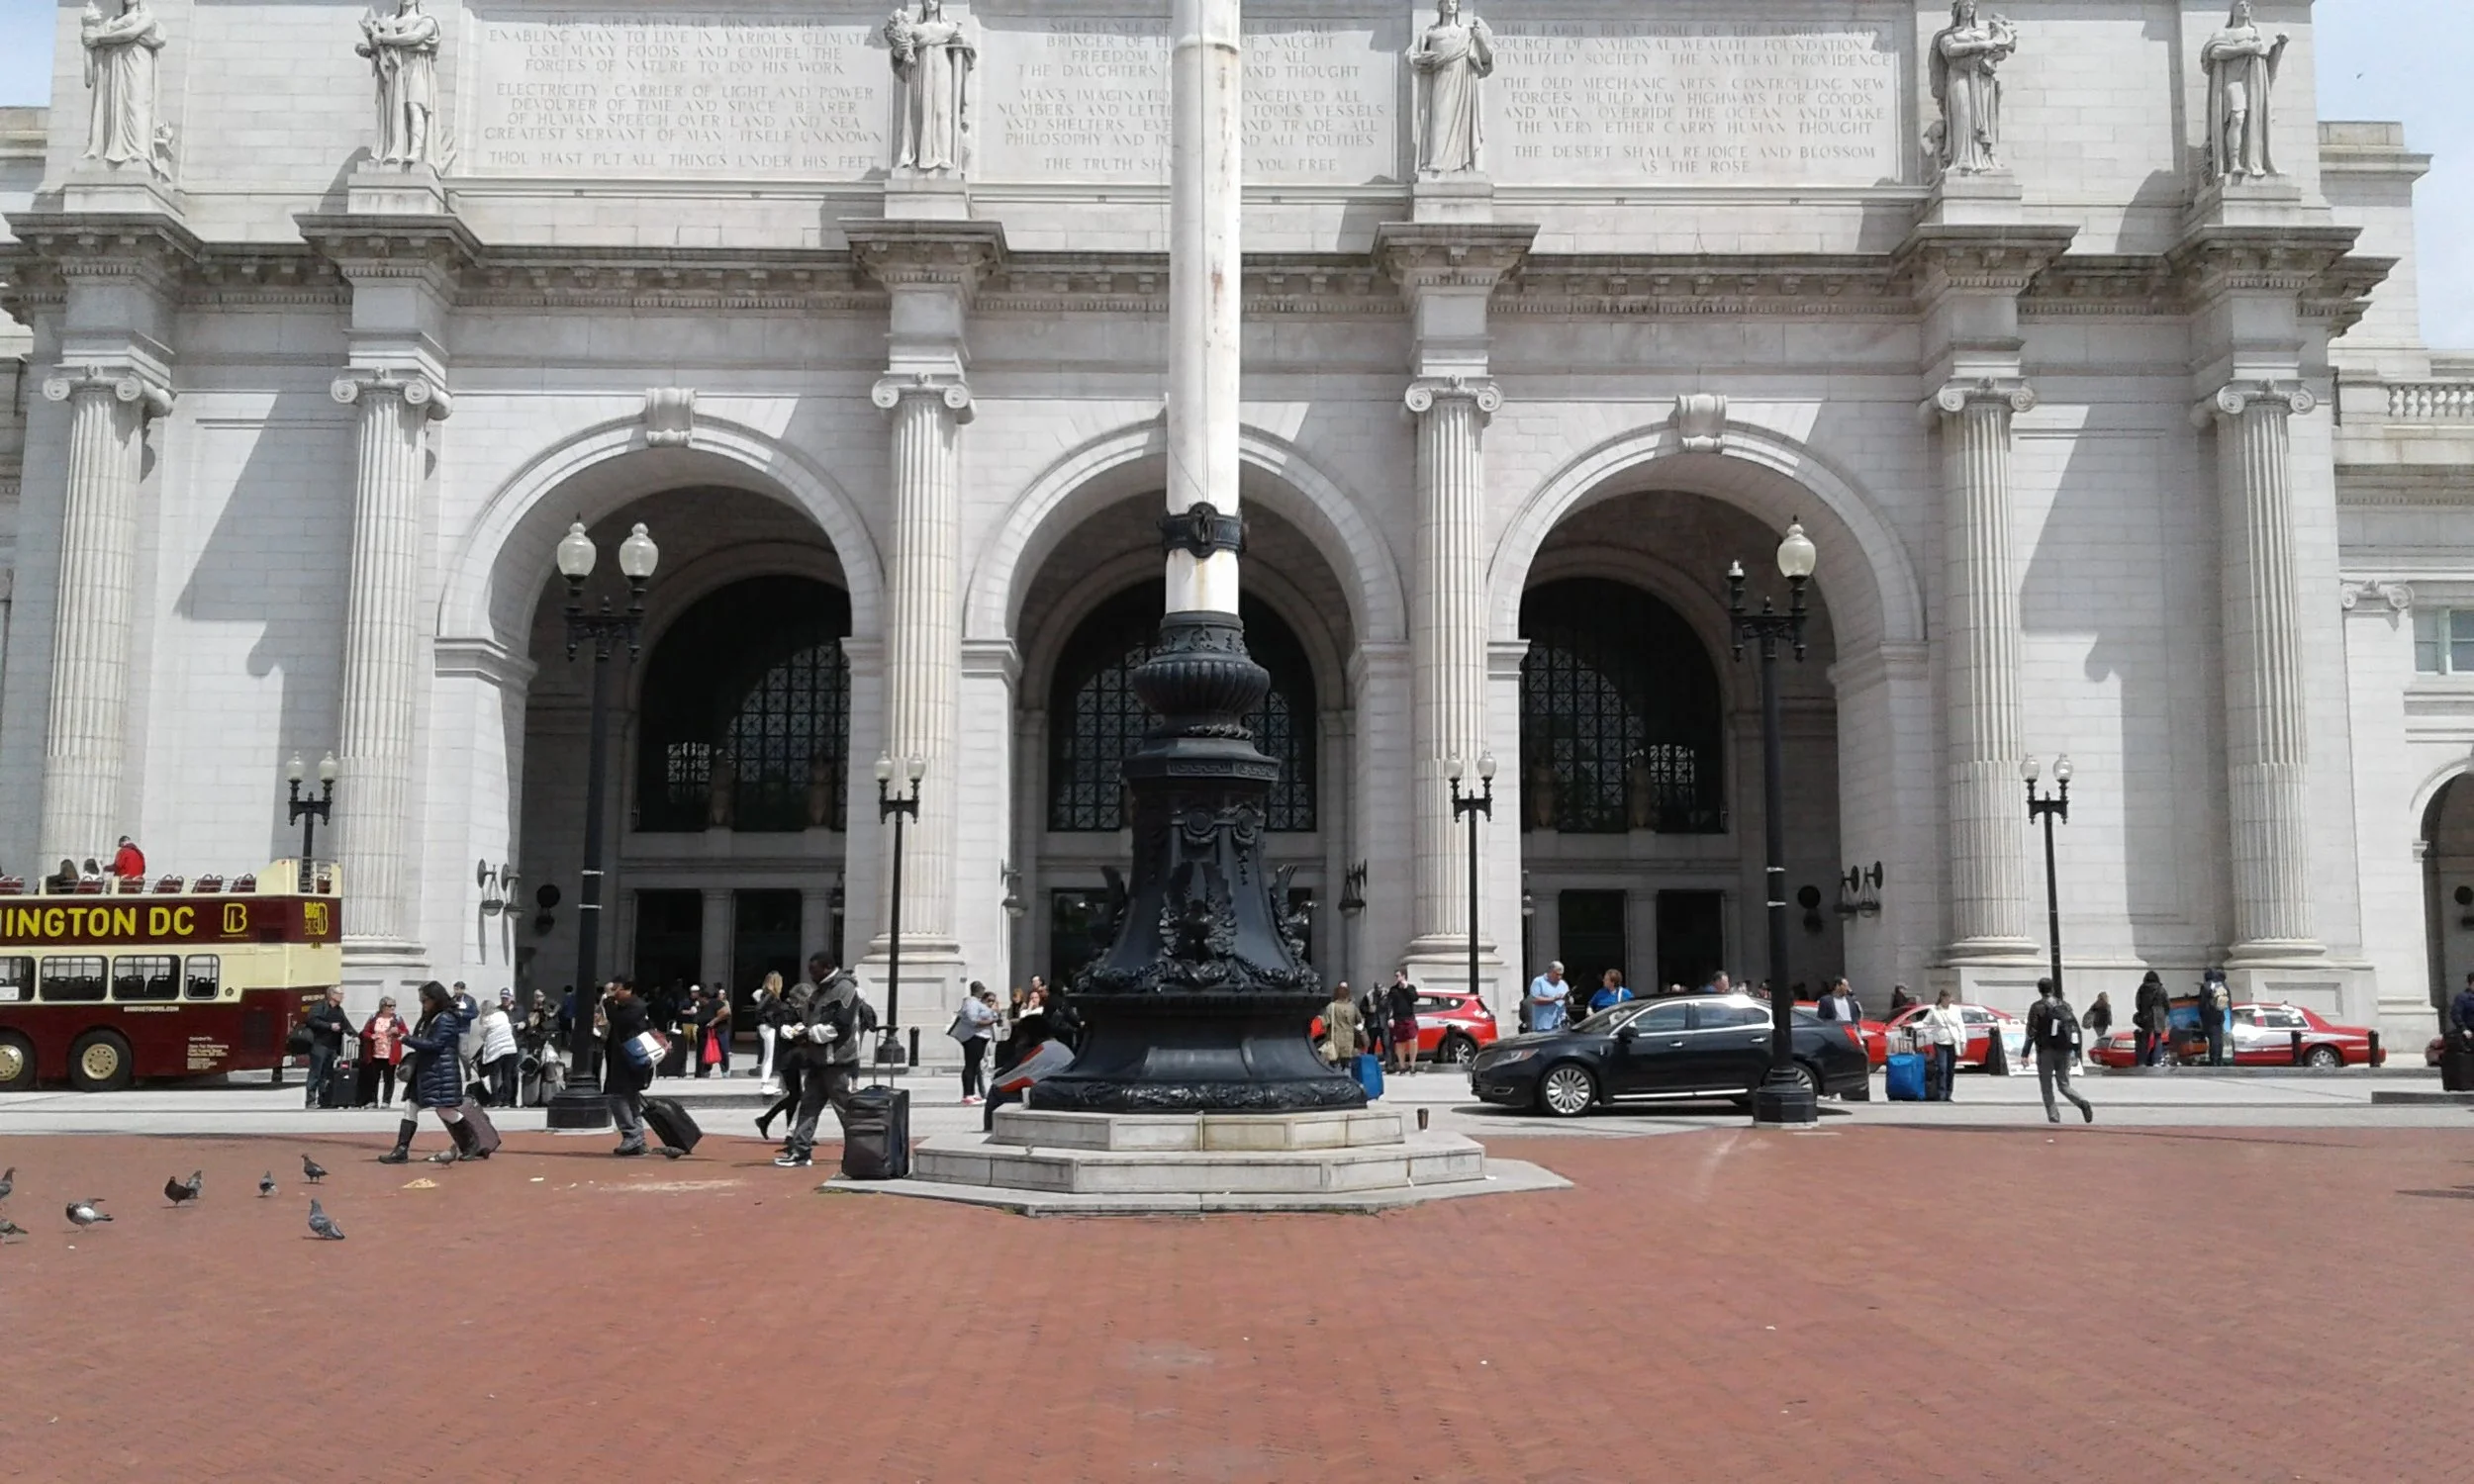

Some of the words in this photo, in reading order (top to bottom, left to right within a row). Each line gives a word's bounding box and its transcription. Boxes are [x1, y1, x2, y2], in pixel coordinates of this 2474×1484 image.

[489, 30, 570, 43] ENABLING
[581, 31, 615, 43] MAN
[625, 31, 645, 44] TO
[655, 31, 689, 44] LIVE
[699, 31, 712, 44] IN
[725, 31, 793, 44] VARIOUS
[1046, 37, 1114, 47] BRINGER
[1125, 38, 1146, 48] OF
[1240, 37, 1259, 48] OF
[1270, 37, 1334, 49] NAUGHT
[1493, 39, 1558, 49] SOURCE
[1566, 39, 1584, 49] OF
[1596, 40, 1673, 50] NATIONAL
[1680, 40, 1747, 51] WEALTH
[1764, 41, 1862, 51] FOUNDATION
[1872, 41, 1891, 51] OF
[529, 45, 560, 56] USE
[571, 45, 618, 57] MANY
[627, 46, 680, 57] FOODS
[696, 46, 728, 57] AND
[738, 46, 801, 59] COMPEL
[814, 47, 842, 60] THE
[1072, 50, 1148, 62] FREEDOM
[1254, 51, 1271, 62] OF
[1284, 51, 1308, 63] ALL
[1495, 53, 1574, 65] CIVILIZED
[1584, 53, 1649, 65] SOCIETY
[1670, 54, 1699, 65] THE
[1710, 54, 1778, 66] NATURAL
[1792, 55, 1891, 66] PROVIDENCE
[525, 59, 587, 71] FORCES
[597, 59, 616, 72] OF
[626, 60, 688, 72] NATURE
[699, 61, 719, 73] TO
[729, 61, 752, 73] DO
[763, 61, 788, 74] HIS
[799, 61, 844, 75] WORK
[1017, 64, 1051, 77] THE
[1063, 65, 1158, 77] DAUGHTERS
[1244, 66, 1277, 78] AND
[1285, 66, 1361, 78] THOUGHT
[1501, 77, 1530, 89] THE
[1542, 78, 1572, 89] OLD
[1582, 78, 1668, 90] MECHANIC
[1679, 78, 1716, 90] ARTS
[1852, 79, 1885, 90] NEW
[497, 83, 598, 96] ELECTRICITY
[616, 84, 683, 97] CARRIER
[692, 85, 710, 97] OF
[722, 86, 767, 98] LIGHT
[778, 86, 810, 98] AND
[820, 87, 874, 100] POWER
[1078, 89, 1170, 102] IMAGINATIO
[1242, 90, 1324, 102] ONCEIVED
[1335, 91, 1362, 102] ALL
[1512, 92, 1572, 104] FORCES
[1586, 92, 1634, 104] BUILD
[1643, 92, 1674, 104] NEW
[1687, 92, 1765, 104] HIGHWAYS
[1778, 93, 1806, 104] FOR
[1818, 93, 1873, 104] GOODS
[513, 98, 597, 112] DEVOURER
[607, 99, 626, 112] OF
[638, 99, 672, 112] TIME
[686, 100, 716, 113] AND
[728, 101, 776, 114] SPACE
[796, 101, 857, 114] BEARER
[998, 104, 1074, 116] NUMBERS
[1087, 104, 1118, 116] AND
[1253, 105, 1303, 117] TOOLS
[1314, 105, 1385, 118] VESSELS
[1503, 107, 1536, 119] AND
[1547, 107, 1580, 118] MEN
[1598, 108, 1674, 119] OVERRIDE
[1686, 108, 1715, 119] THE
[1725, 108, 1781, 119] OCEAN
[1798, 108, 1830, 120] AND
[1840, 108, 1886, 120] MAKE
[508, 113, 525, 125] OF
[538, 113, 597, 125] HUMAN
[609, 113, 668, 127] SPEECH
[678, 114, 719, 127] OVER
[730, 116, 775, 128] LAND
[788, 116, 820, 129] AND
[830, 116, 860, 129] SEA
[1005, 119, 1037, 131] AND
[1048, 120, 1124, 132] SHELTERS
[1241, 121, 1272, 132] AND
[1283, 121, 1333, 132] TRADE
[1351, 121, 1378, 133] ALL
[484, 128, 566, 139] GREATEST
[576, 128, 646, 140] SERVANT
[657, 129, 676, 141] OF
[685, 130, 721, 141] MAN
[739, 130, 792, 142] ITSELF
[802, 131, 882, 143] UNKNOWN
[1516, 122, 1544, 134] THE
[1553, 122, 1592, 134] VERY
[1605, 122, 1655, 134] ETHER
[1665, 123, 1716, 134] CARRY
[1727, 123, 1785, 135] HUMAN
[1797, 123, 1872, 135] THOUGHT
[1005, 134, 1101, 145] PHILOSOPHY
[1113, 135, 1145, 146] AND
[1272, 137, 1294, 146] ALL
[1307, 136, 1375, 146] POLITIES
[1513, 145, 1543, 158] THE
[1553, 145, 1613, 158] DESERT
[1623, 145, 1671, 158] SHALL
[1683, 145, 1748, 158] REJOICE
[1759, 146, 1790, 159] AND
[1800, 146, 1876, 159] BLOSSOM
[489, 151, 529, 164] THOU
[541, 151, 583, 165] HAST
[594, 152, 622, 166] PUT
[631, 153, 656, 166] ALL
[670, 153, 727, 167] THINGS
[738, 155, 792, 168] UNDER
[803, 155, 828, 168] HIS
[839, 155, 877, 169] FEET
[1045, 158, 1072, 170] THE
[1083, 158, 1132, 171] TRUTH
[1257, 159, 1285, 171] YOU
[1299, 160, 1338, 172] FREE
[1641, 161, 1658, 173] AS
[1670, 161, 1698, 173] THE
[1710, 161, 1752, 173] ROSE
[0, 907, 137, 938] INGTON
[148, 906, 195, 936] DC
